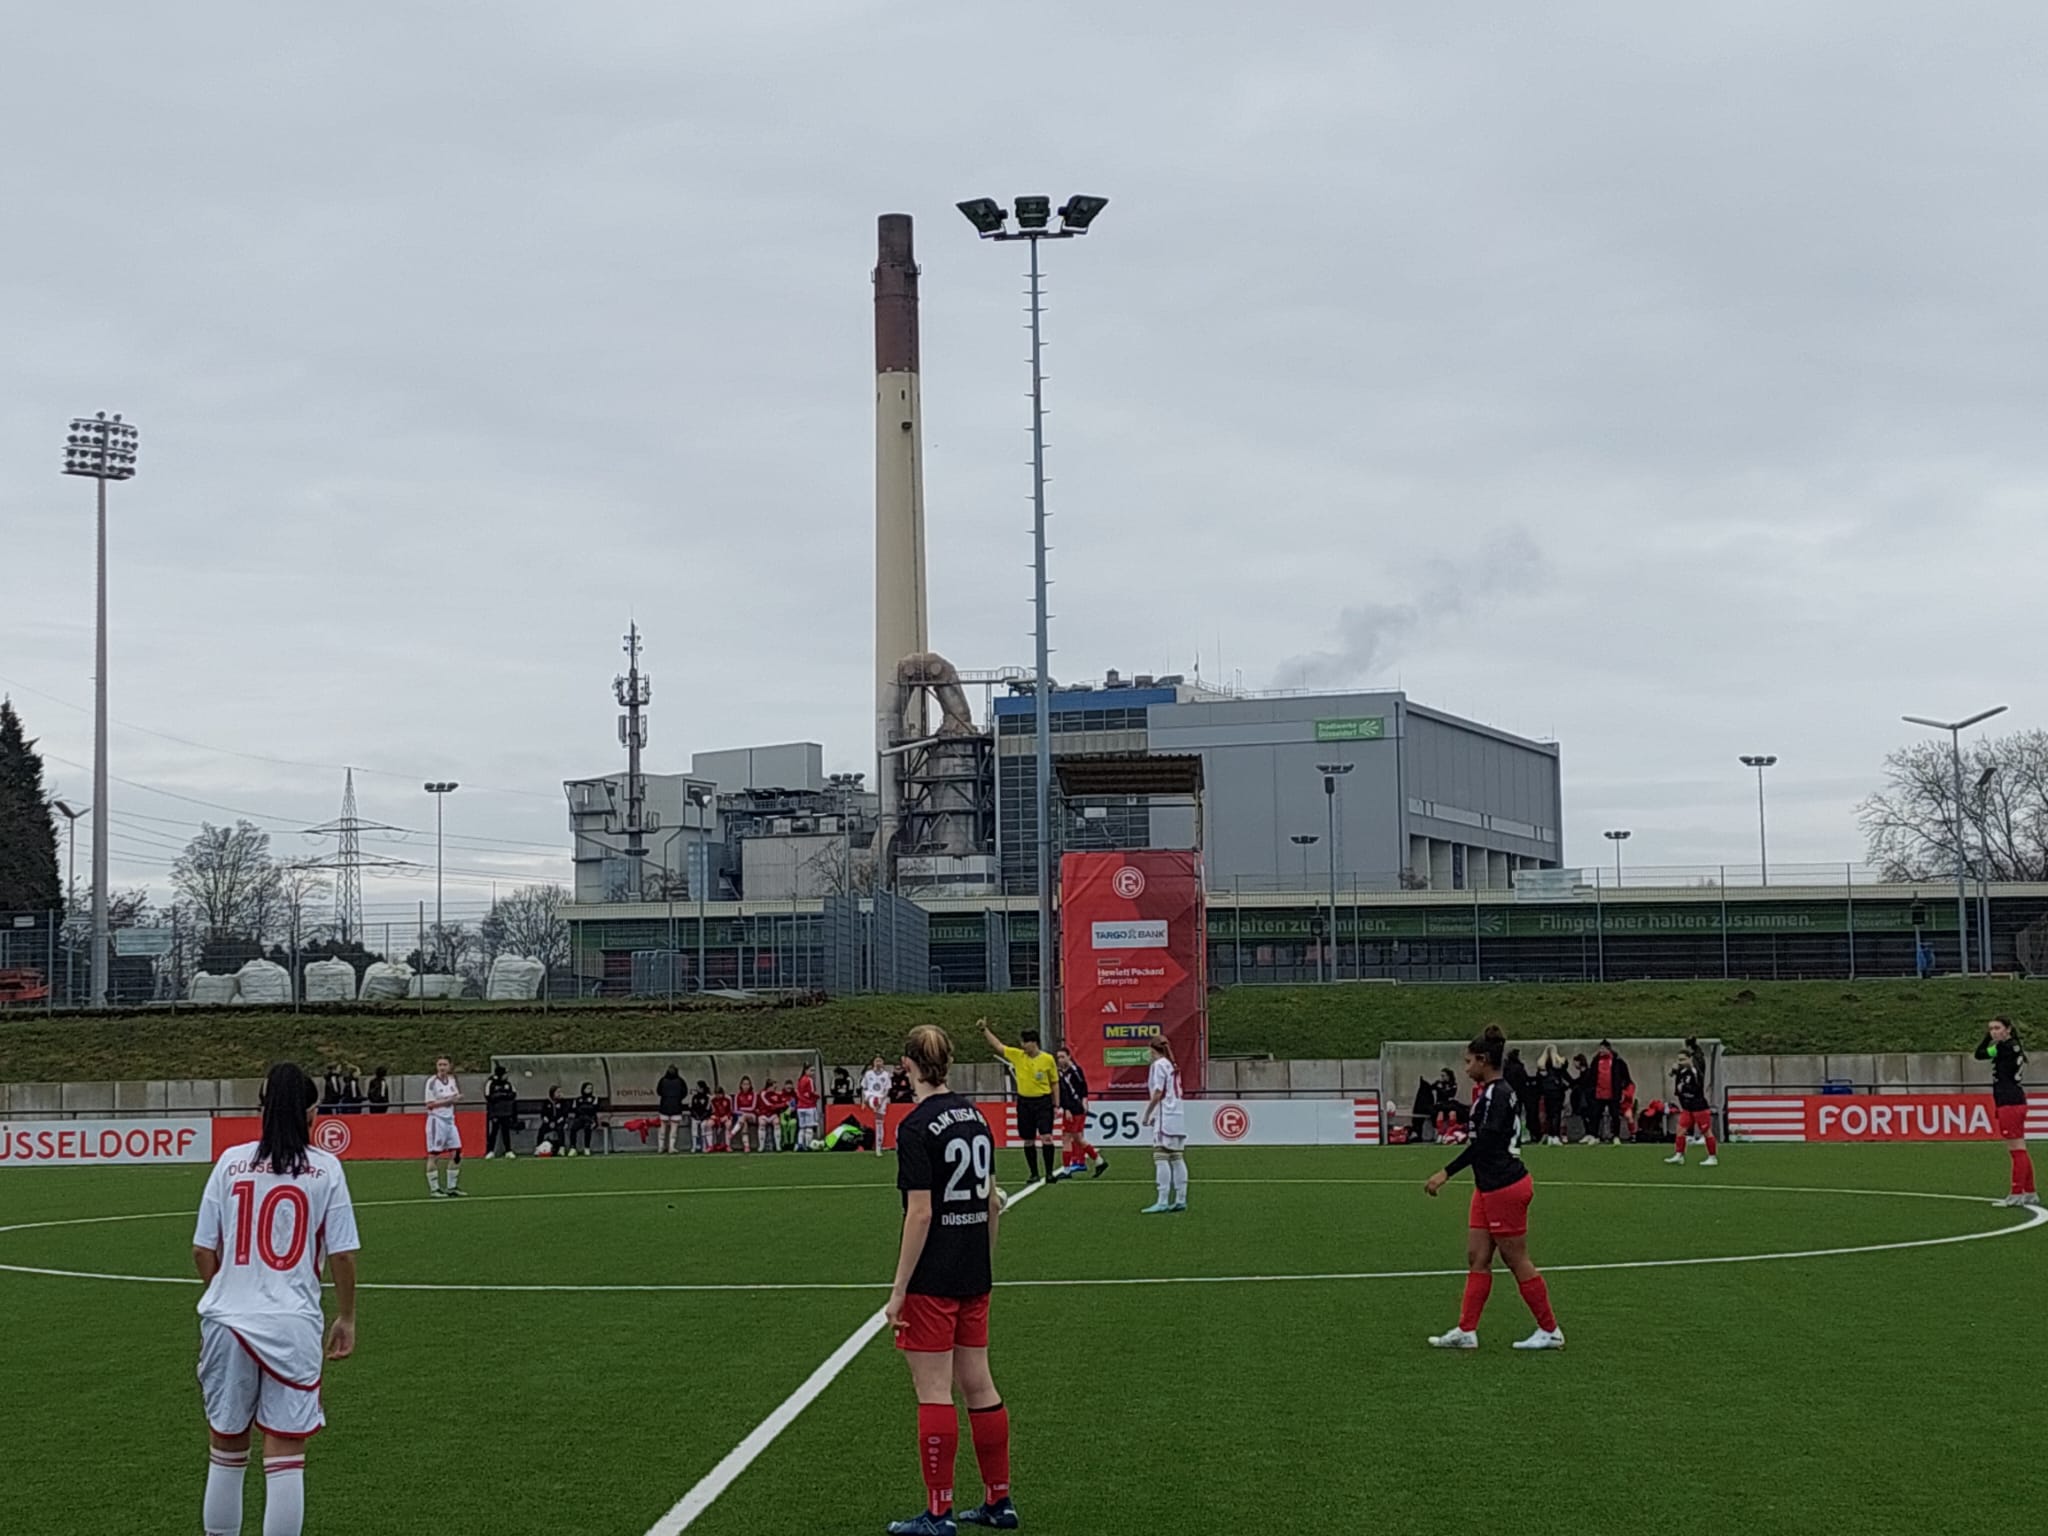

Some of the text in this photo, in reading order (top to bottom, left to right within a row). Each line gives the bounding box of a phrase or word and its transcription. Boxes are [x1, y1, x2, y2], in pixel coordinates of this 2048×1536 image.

[1540, 914, 1645, 932] Flingeaner
[1649, 911, 1707, 929] halten
[1105, 1025, 1161, 1038] METRO
[928, 1110, 954, 1136] DJK
[1819, 1104, 1993, 1135] FORTUNA
[943, 1134, 991, 1202] 29
[231, 1180, 310, 1272] 10
